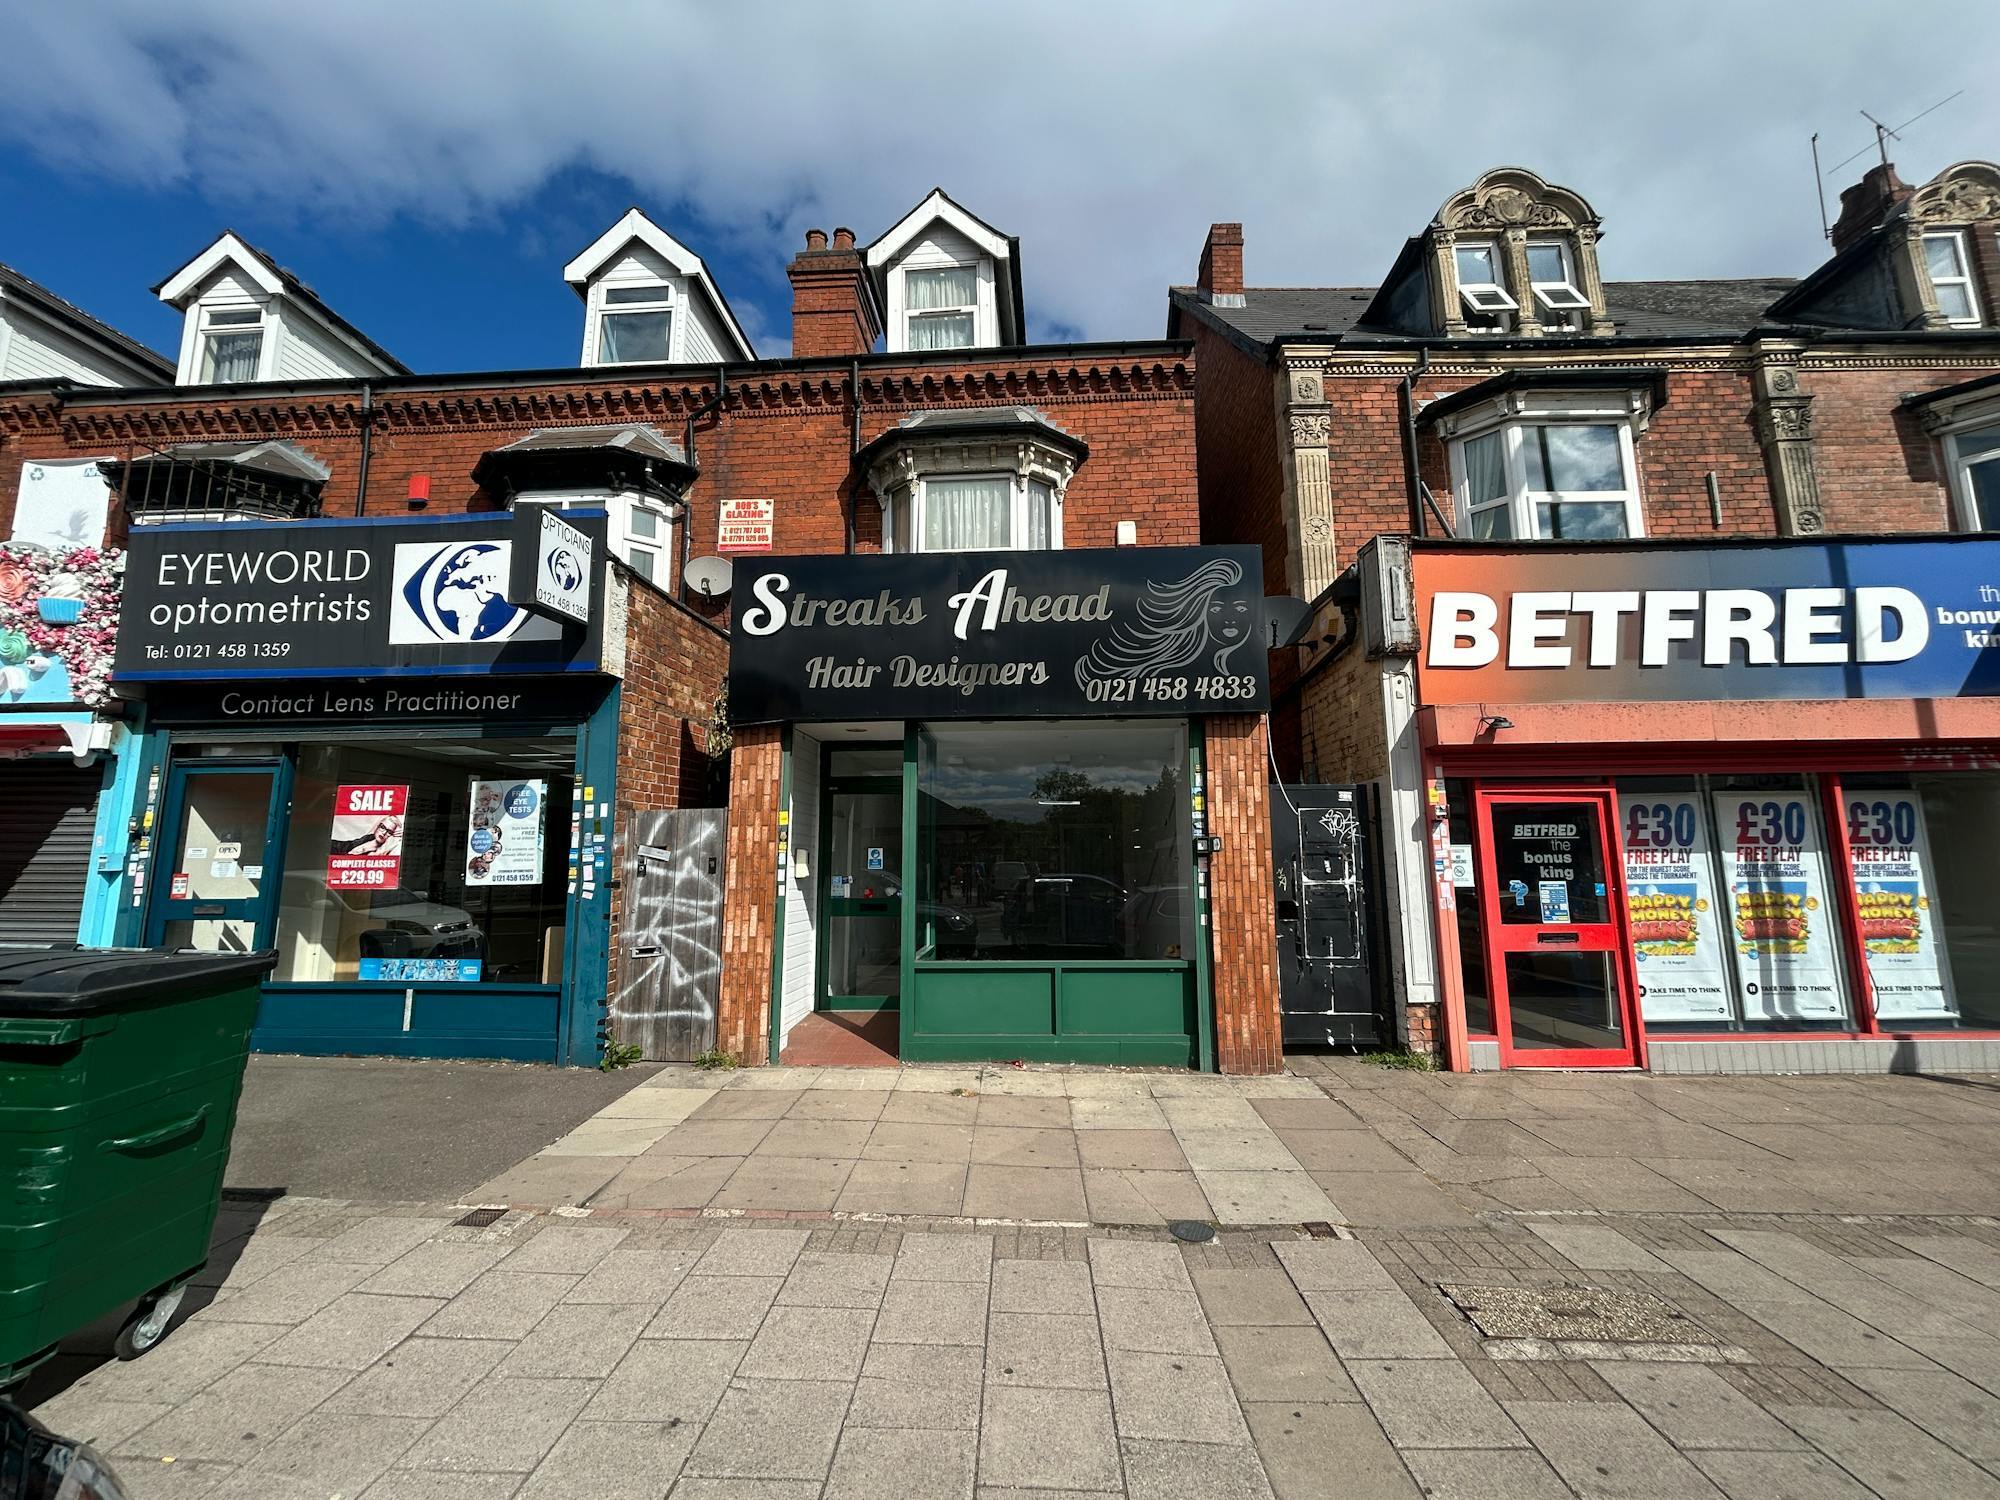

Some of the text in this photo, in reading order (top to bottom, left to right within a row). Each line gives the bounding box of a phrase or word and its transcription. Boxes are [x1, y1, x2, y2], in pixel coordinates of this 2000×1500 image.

[735, 501, 759, 510] BOB'S
[725, 510, 764, 519] GLAZING
[541, 513, 591, 555] OPTICIANS
[158, 549, 371, 586] EYEWORLD
[1978, 584, 2000, 603] th
[537, 588, 588, 619] 0121 458 1359
[741, 568, 1113, 641] Streaks Ahead
[149, 592, 371, 634] optometrists
[1936, 606, 2000, 625] bonu
[1428, 587, 1930, 667] BETFRED
[1964, 629, 2000, 648] kin
[145, 643, 291, 659] Tel: 0121 458 1359
[805, 654, 1051, 696] Hair Designers
[1086, 675, 1256, 702] 0121 458 4833
[221, 690, 521, 715] Contact Lens Practitioner
[348, 789, 394, 812] SALE
[509, 806, 532, 814] TESTS
[1513, 824, 1577, 837] BETFRED
[1626, 803, 1696, 847] £30
[1736, 802, 1806, 846] £30
[1848, 801, 1916, 845] £30
[219, 846, 238, 854] OPEN
[1550, 839, 1571, 851] the
[1523, 851, 1573, 864] bonus
[1627, 848, 1692, 864] FREE PLAY
[1736, 847, 1803, 862] FREE PLAY
[1850, 847, 1913, 862] FREE PLAY
[331, 859, 396, 869] COMPLETE GLASSES
[1649, 865, 1672, 873] HIGHEST
[1673, 865, 1691, 873] SCORE
[340, 869, 385, 885] £29.99
[519, 874, 534, 882] 1359
[1540, 866, 1574, 880] king
[1661, 872, 1697, 880] TOURNAMENT
[1628, 894, 1691, 910] HAPPY
[1737, 893, 1802, 908] HAPPY
[1630, 908, 1692, 921] MONEY
[1739, 907, 1802, 920] MONEY
[1631, 920, 1692, 941] HENS
